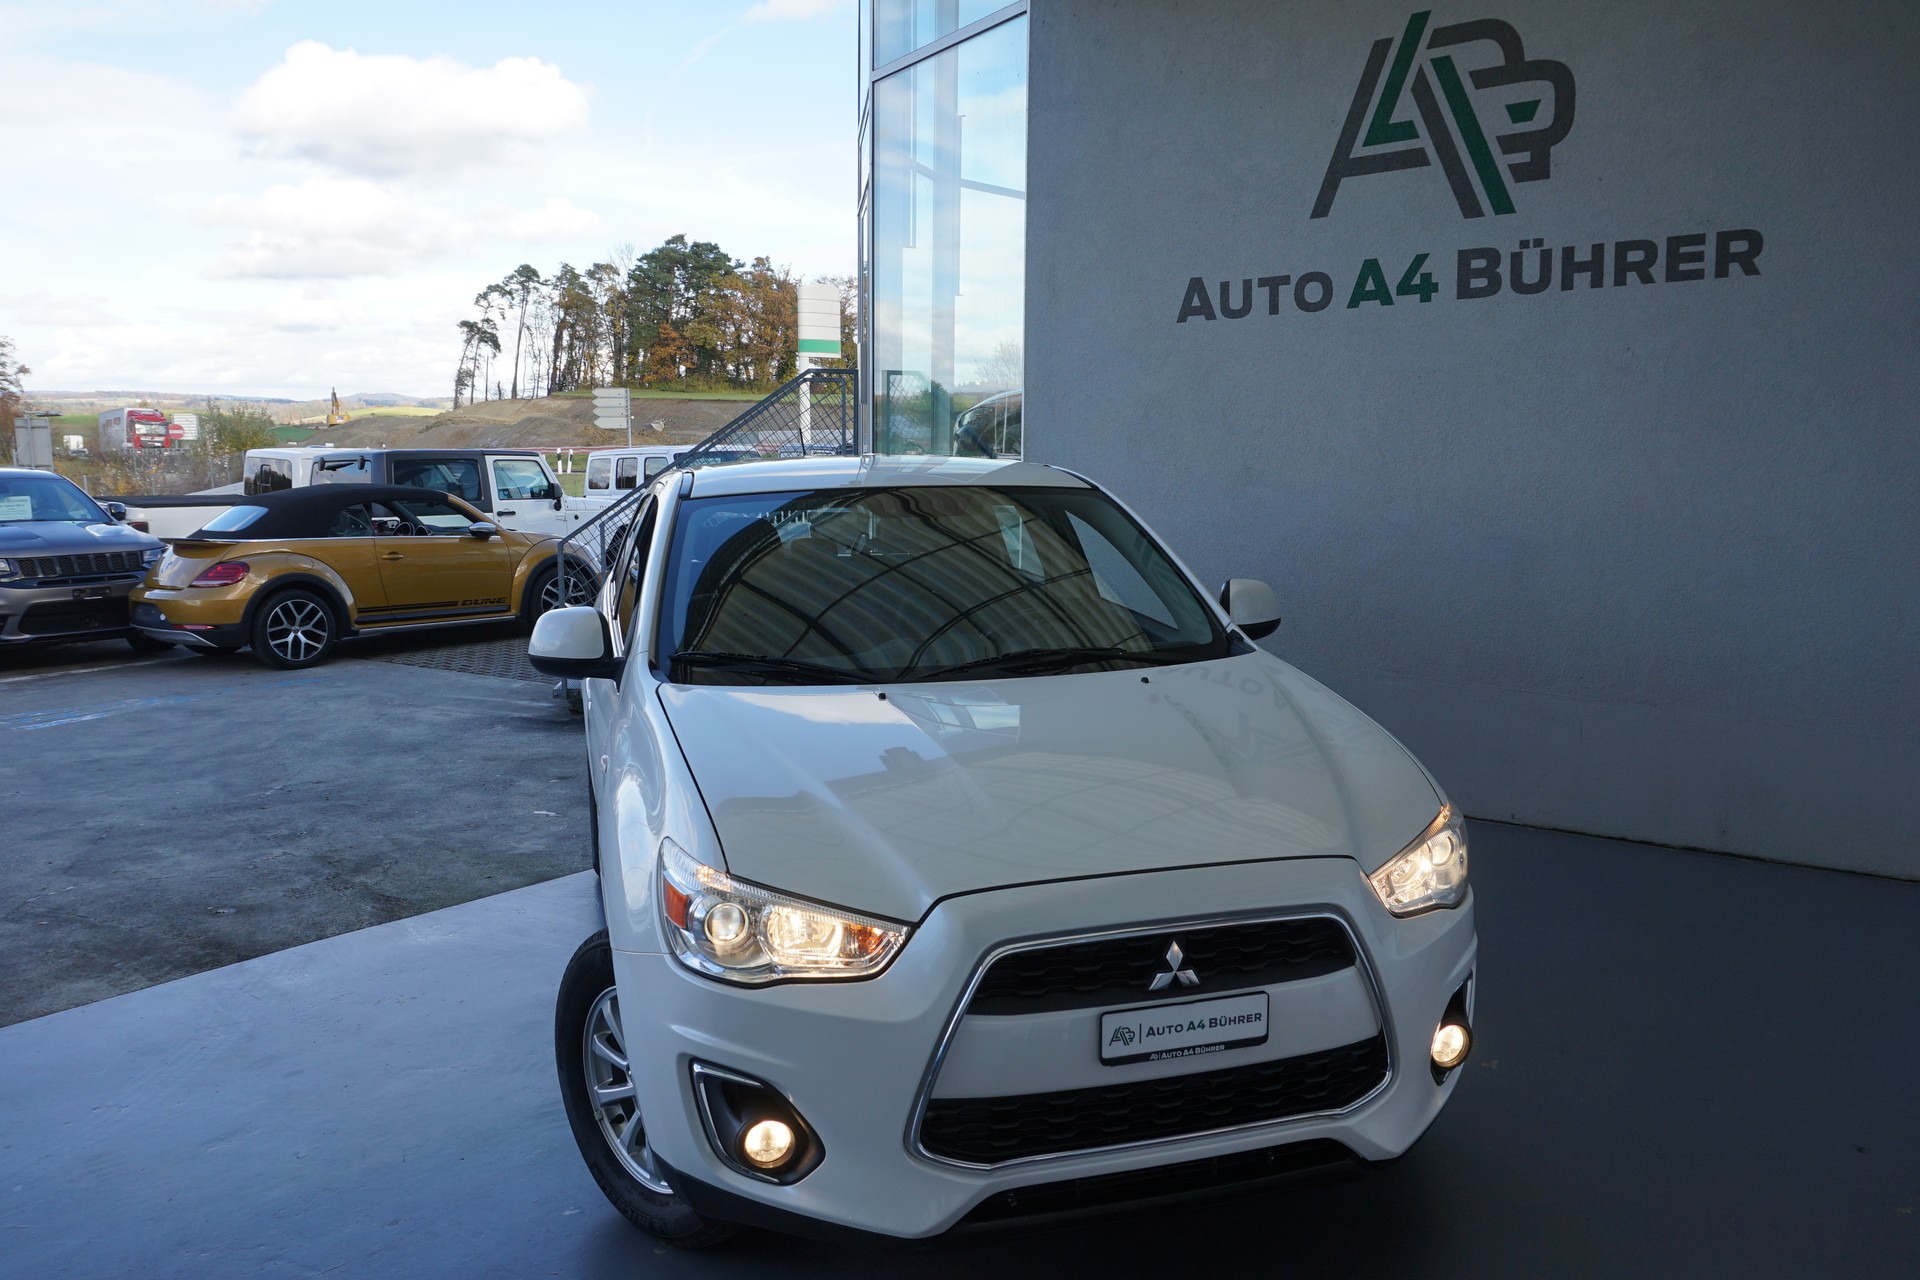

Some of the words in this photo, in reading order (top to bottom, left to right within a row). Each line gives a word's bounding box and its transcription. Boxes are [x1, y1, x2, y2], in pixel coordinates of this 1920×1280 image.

[1176, 271, 1333, 323] AUTO
[1347, 253, 1439, 309] A4
[1456, 229, 1764, 300] BÜHRER
[461, 597, 508, 606] DUNE
[1146, 1024, 1184, 1038] AUTO
[1186, 1020, 1205, 1032] A4
[1208, 1013, 1262, 1028] BÜHRER
[1195, 1045, 1225, 1054] BÜHRER
